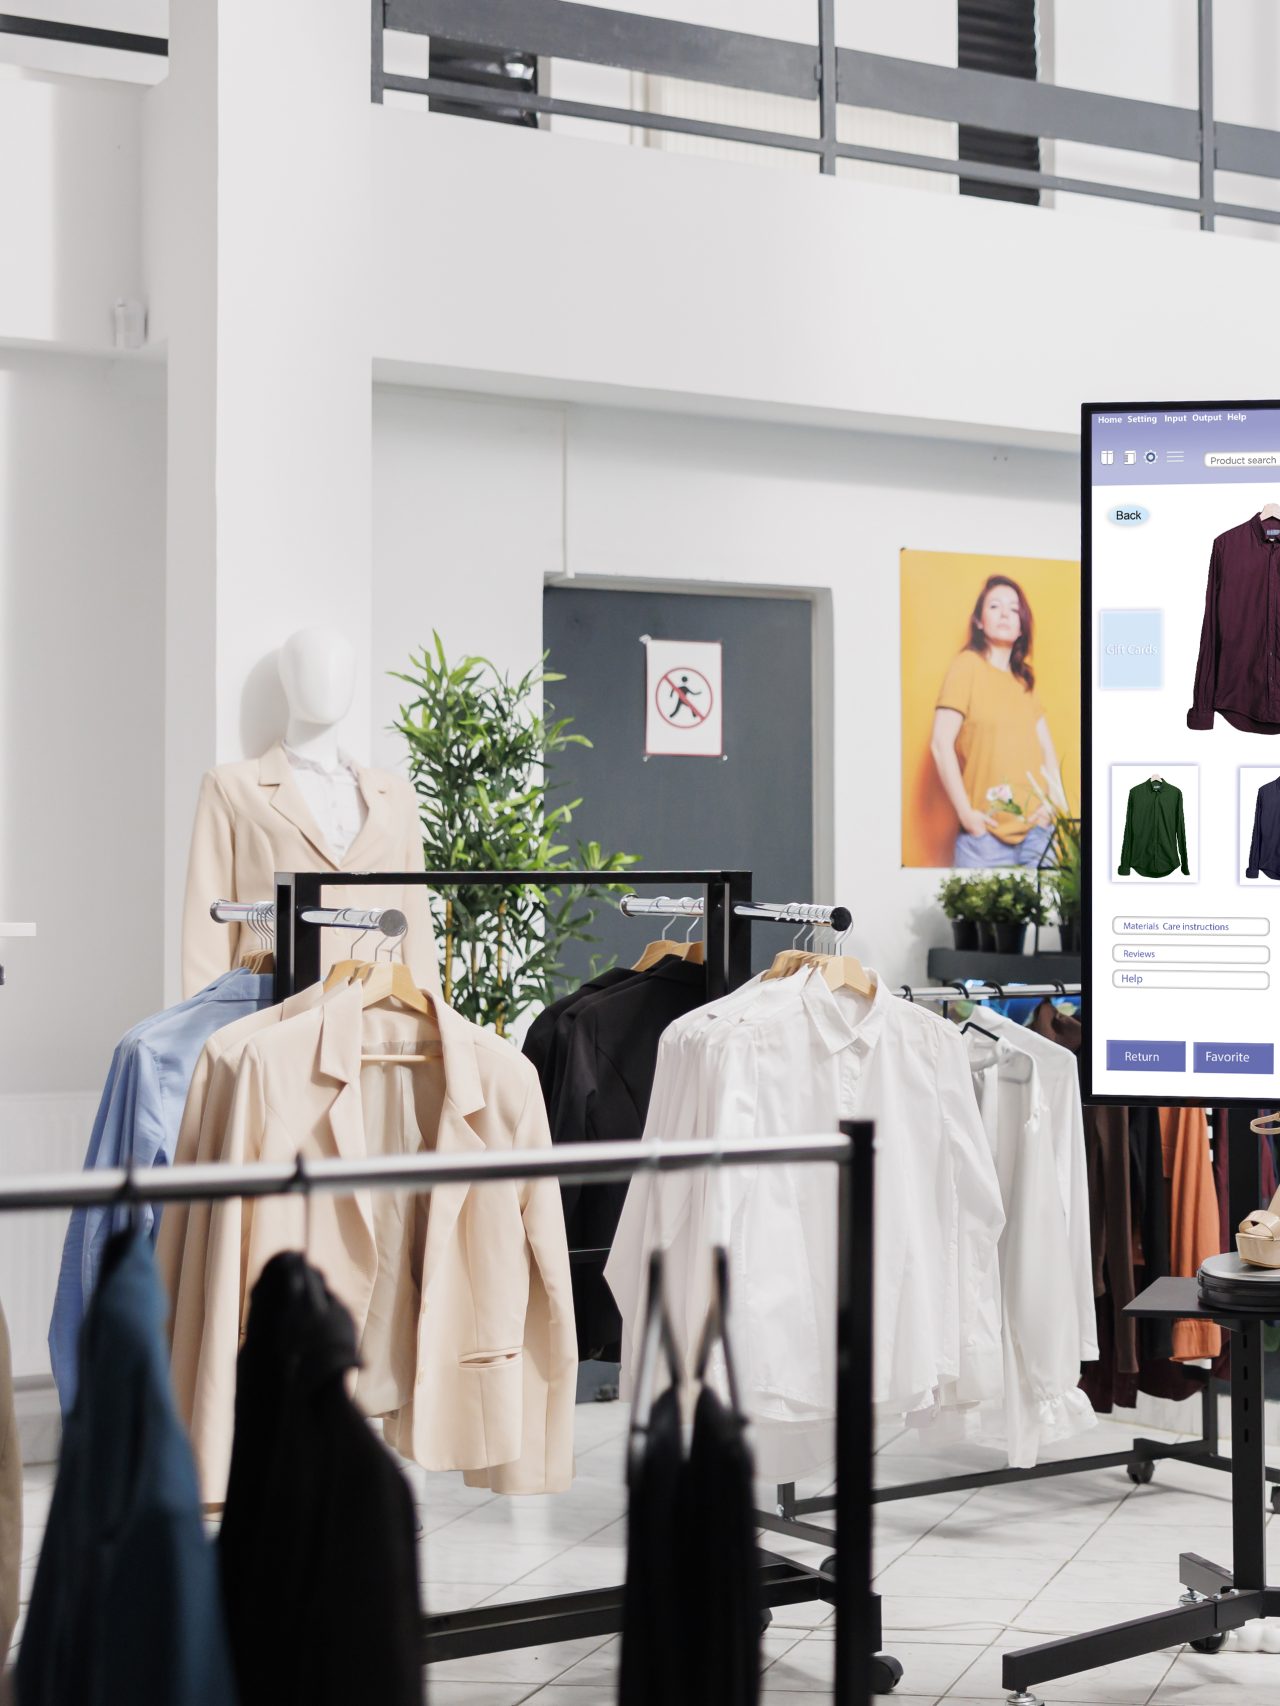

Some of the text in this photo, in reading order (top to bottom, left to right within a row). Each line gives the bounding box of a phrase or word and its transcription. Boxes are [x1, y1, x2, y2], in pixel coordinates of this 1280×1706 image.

[1098, 412, 1247, 425] Home Setting Input Output Help
[1210, 455, 1277, 465] Product search
[1116, 510, 1142, 521] Back
[1105, 643, 1158, 656] Gift Cards
[1123, 921, 1229, 932] Materials Care instructions
[1123, 949, 1156, 958] Reviews
[1121, 974, 1143, 985] Help
[1124, 1051, 1160, 1063] Return
[1205, 1051, 1250, 1063] Favorite
